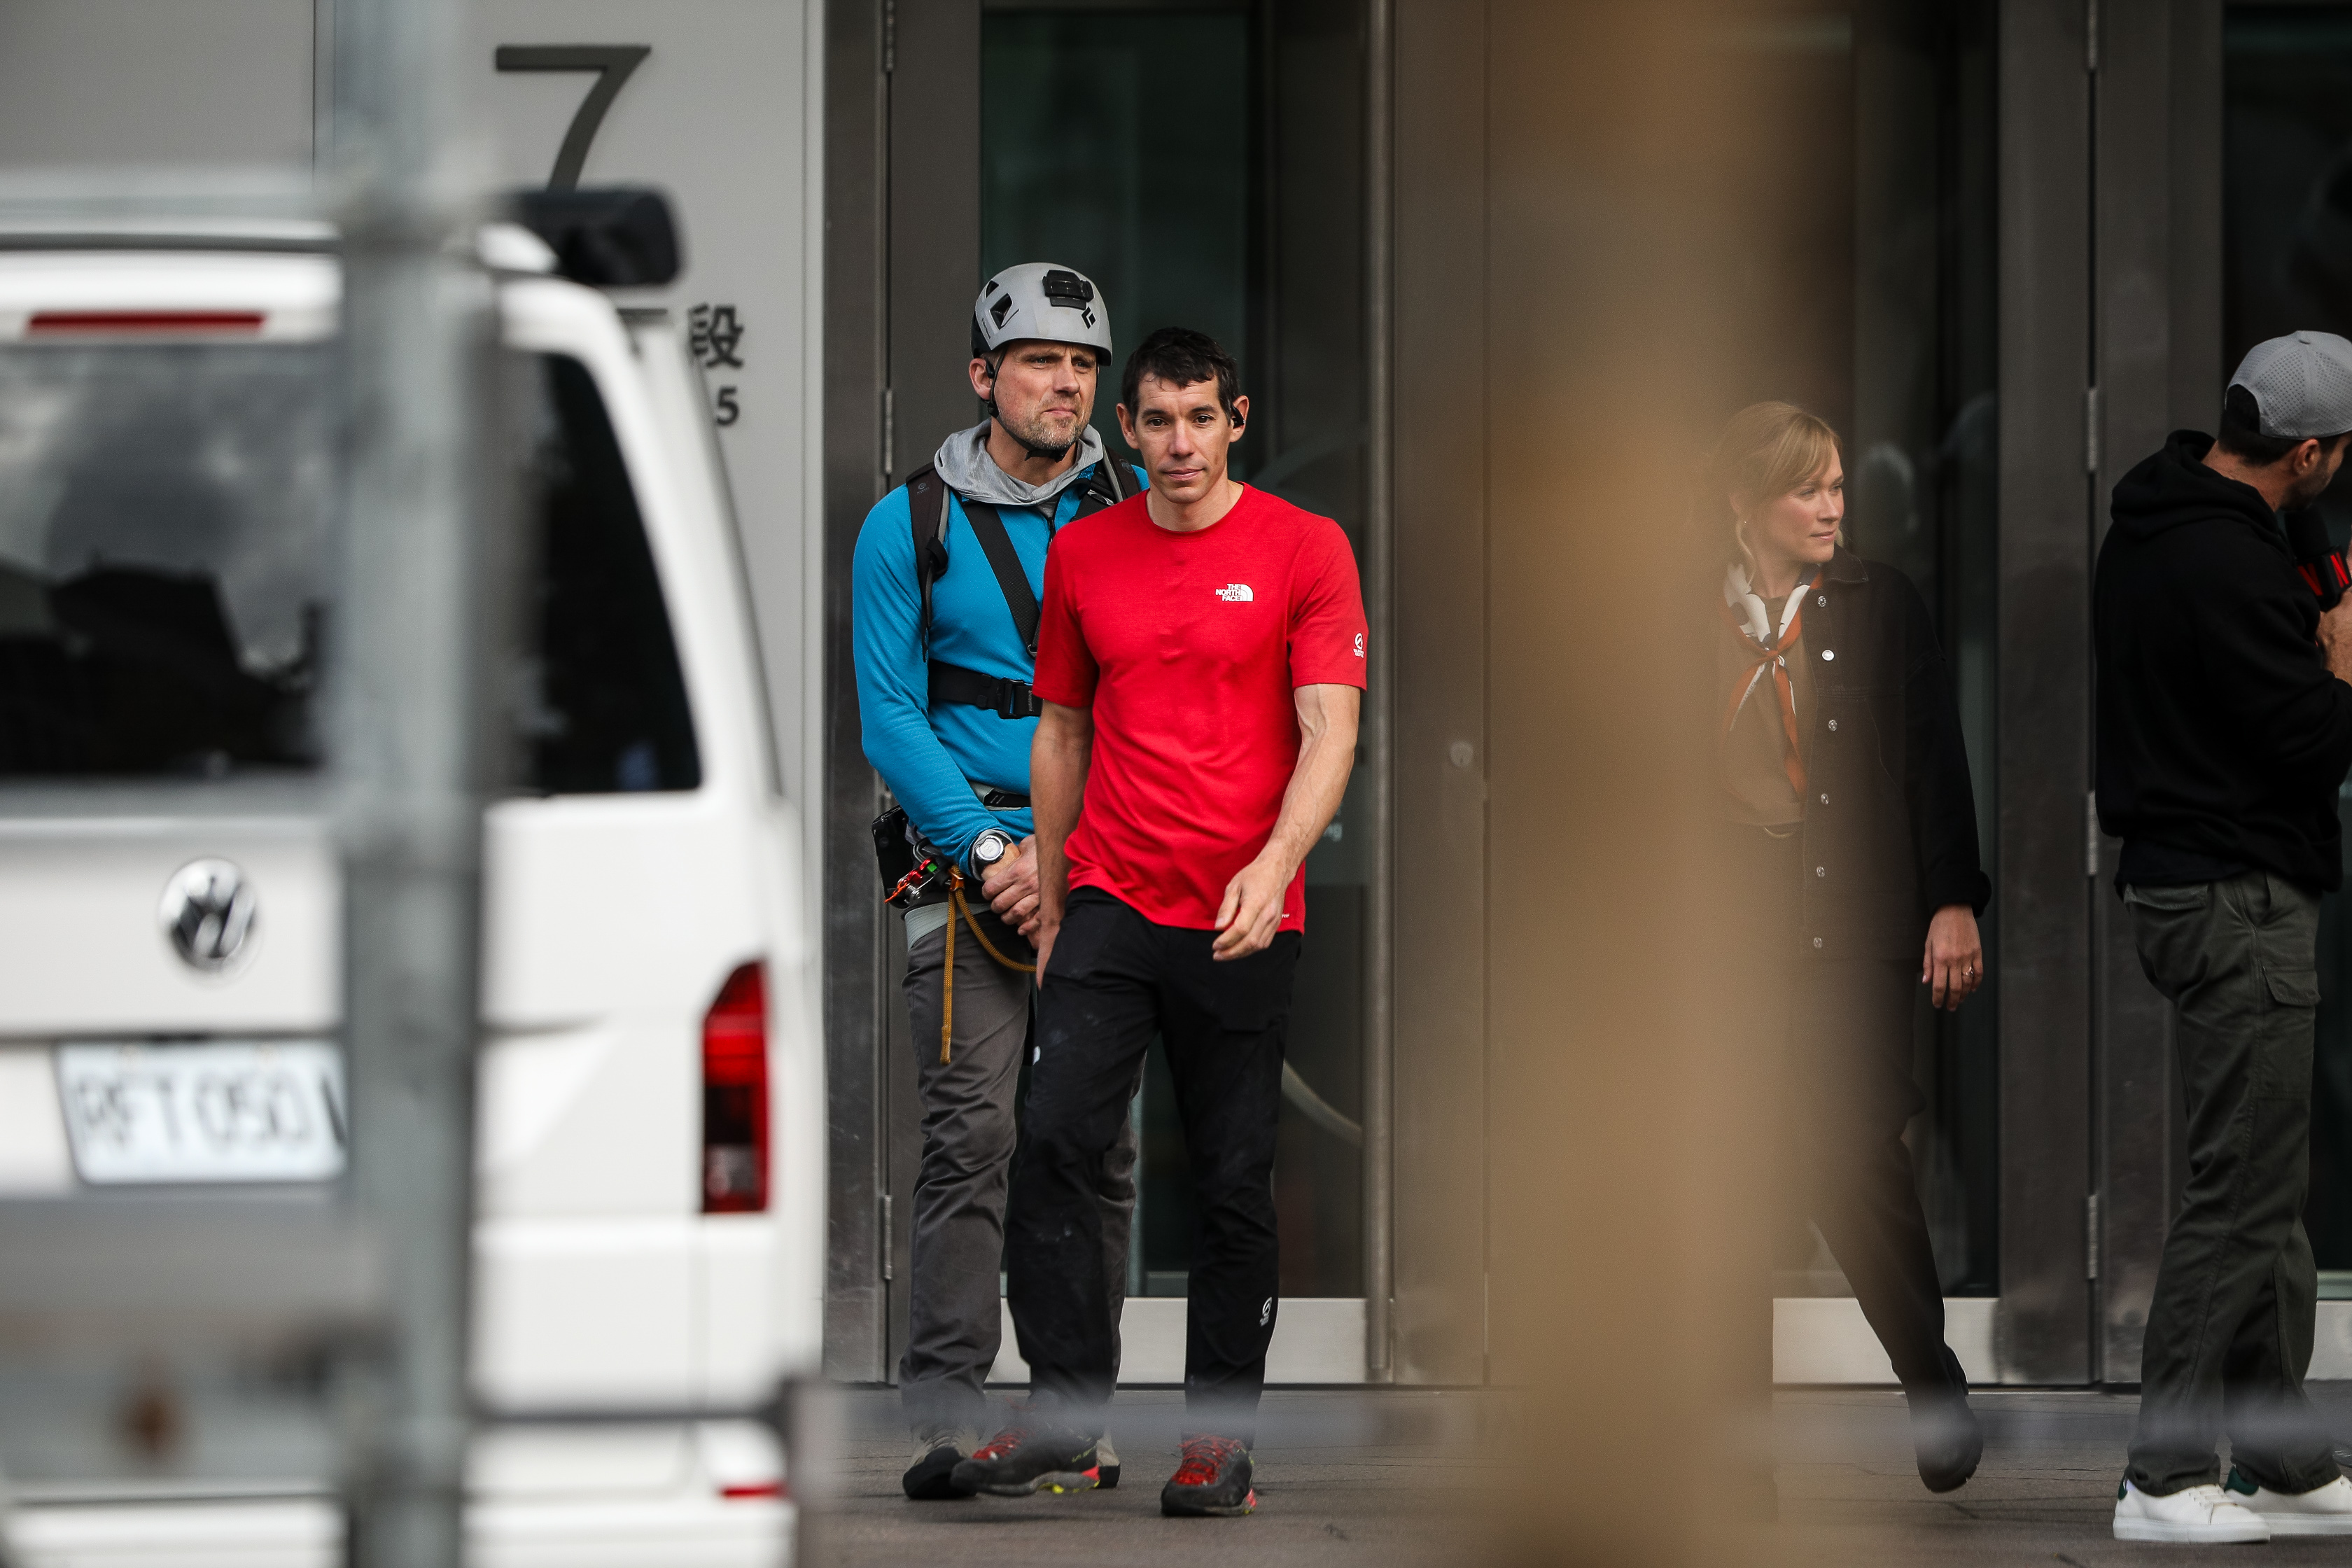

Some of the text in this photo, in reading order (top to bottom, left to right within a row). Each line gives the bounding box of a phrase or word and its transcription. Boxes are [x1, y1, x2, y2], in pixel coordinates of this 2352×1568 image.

[495, 43, 652, 191] 7
[716, 386, 740, 426] 5
[2330, 552, 2350, 588] N
